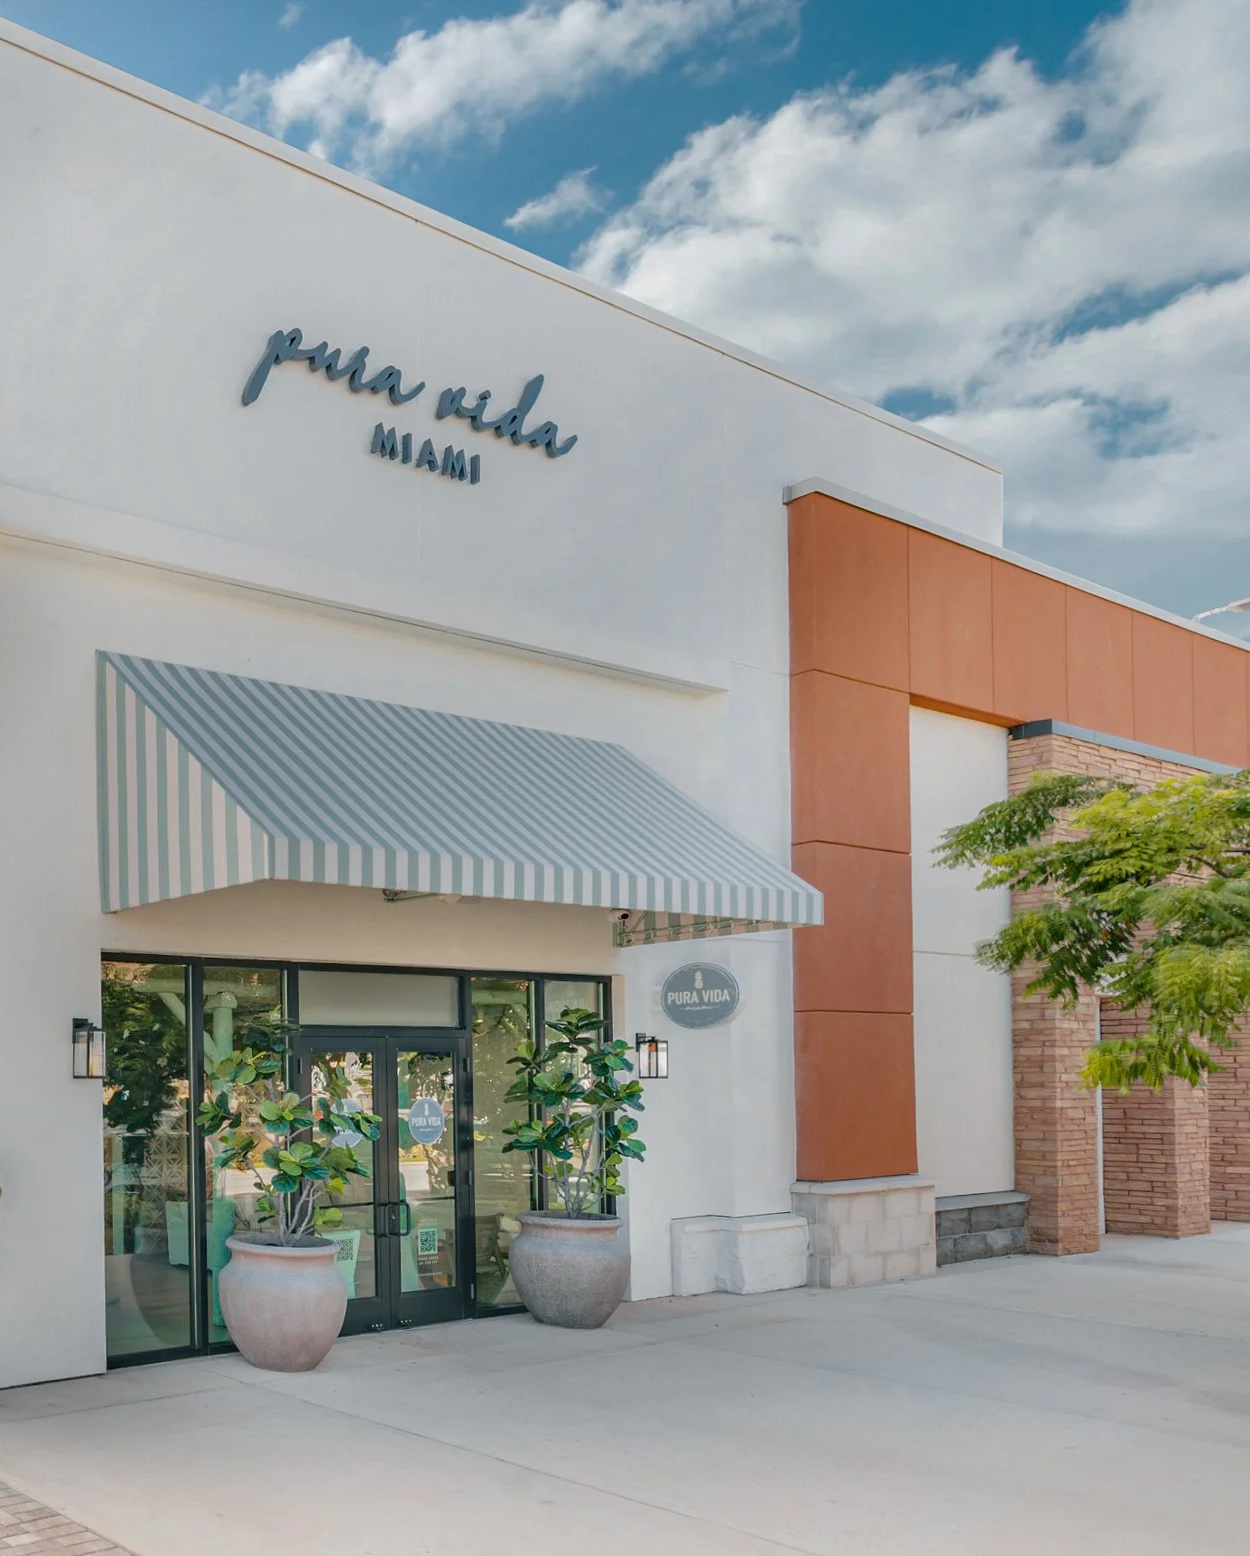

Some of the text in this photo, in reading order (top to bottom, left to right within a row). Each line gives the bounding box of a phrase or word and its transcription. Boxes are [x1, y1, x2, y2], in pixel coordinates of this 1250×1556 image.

[241, 327, 579, 459] pura vida
[370, 422, 481, 485] MIAMI
[667, 988, 731, 1005] PURA VIDA
[411, 1116, 442, 1127] PURA VIDA
